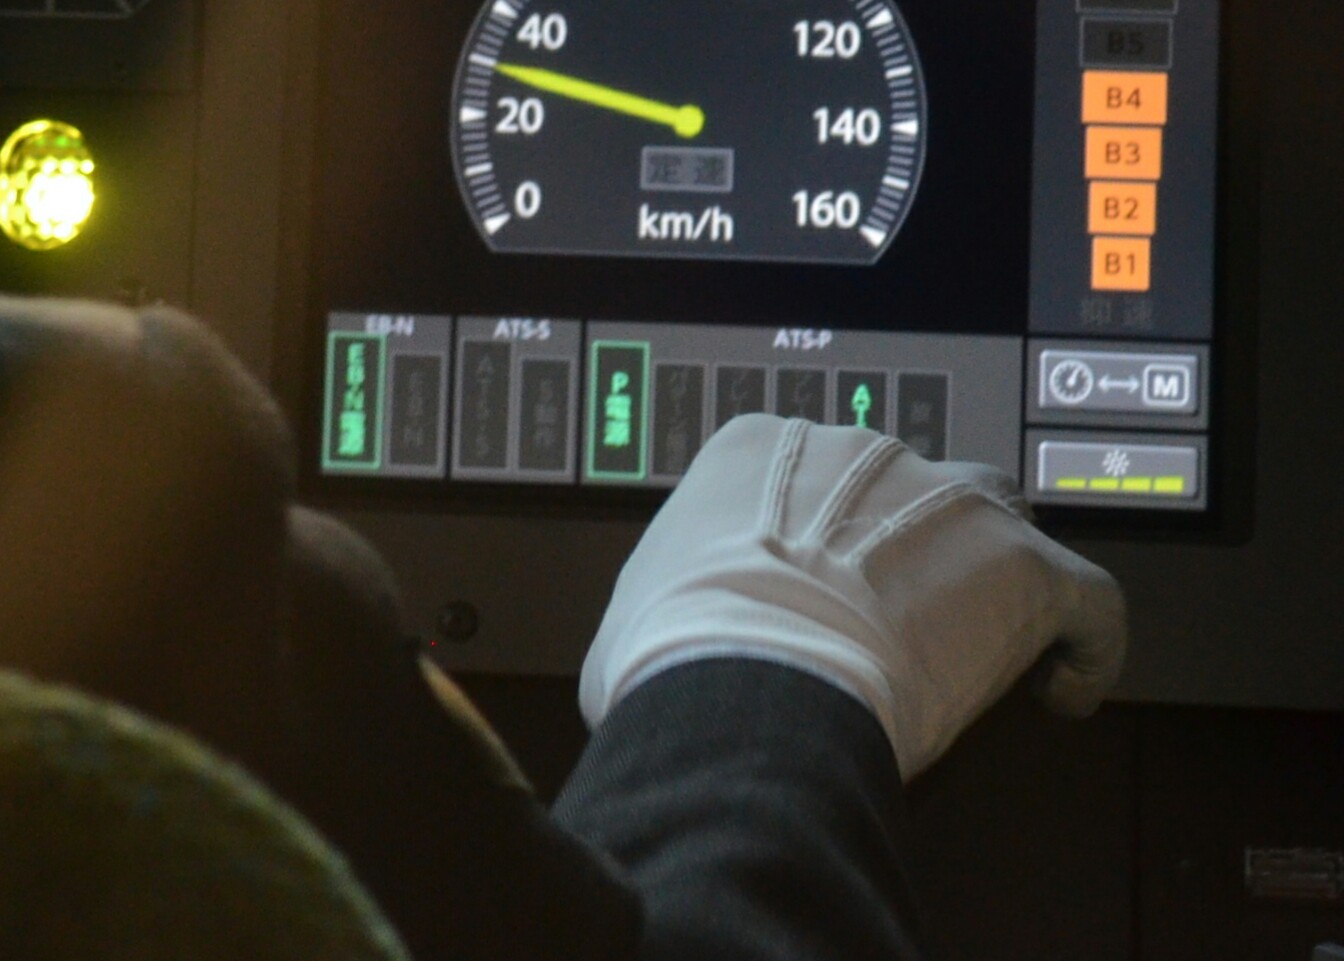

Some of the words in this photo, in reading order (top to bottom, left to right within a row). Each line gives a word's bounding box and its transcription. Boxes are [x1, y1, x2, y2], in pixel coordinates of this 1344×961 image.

[517, 12, 568, 51] 40
[793, 19, 862, 58] 120
[1105, 86, 1143, 110] B4
[496, 97, 544, 136] 20
[812, 106, 881, 145] 140
[1104, 141, 1142, 166] B3
[514, 182, 542, 219] 0
[792, 191, 862, 229] 160
[1103, 196, 1139, 221] B2
[638, 204, 735, 244] km/h
[1103, 252, 1137, 277] B1
[492, 318, 552, 342] ATS-S
[772, 327, 833, 352] ATS-P
[1153, 374, 1180, 399] M
